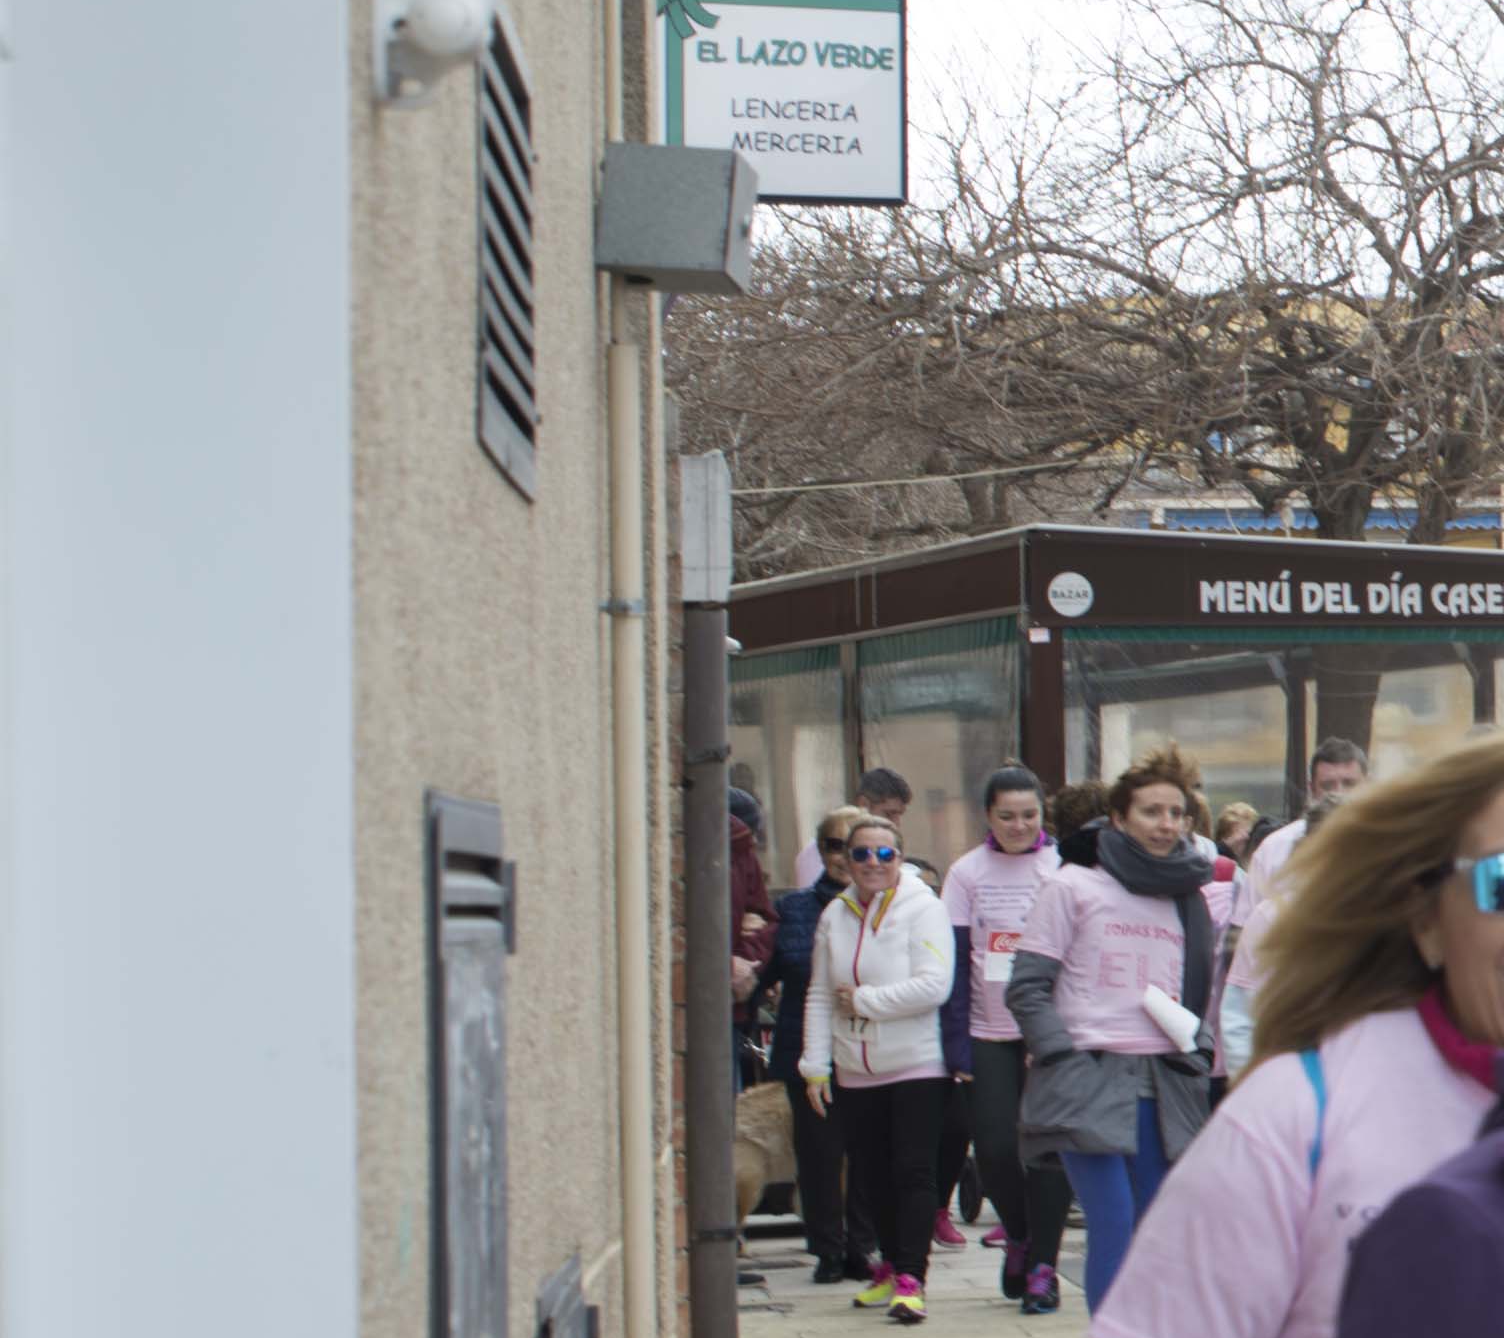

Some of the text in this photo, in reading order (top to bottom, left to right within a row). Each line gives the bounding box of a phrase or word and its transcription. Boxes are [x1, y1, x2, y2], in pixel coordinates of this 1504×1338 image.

[697, 36, 895, 71] EL LAZO VERDE
[730, 97, 859, 122] LENCERIA
[732, 131, 863, 155] MERCERIA
[1199, 569, 1292, 614] MENÚ
[1300, 581, 1361, 614] DEL
[1366, 571, 1423, 618] DÍA
